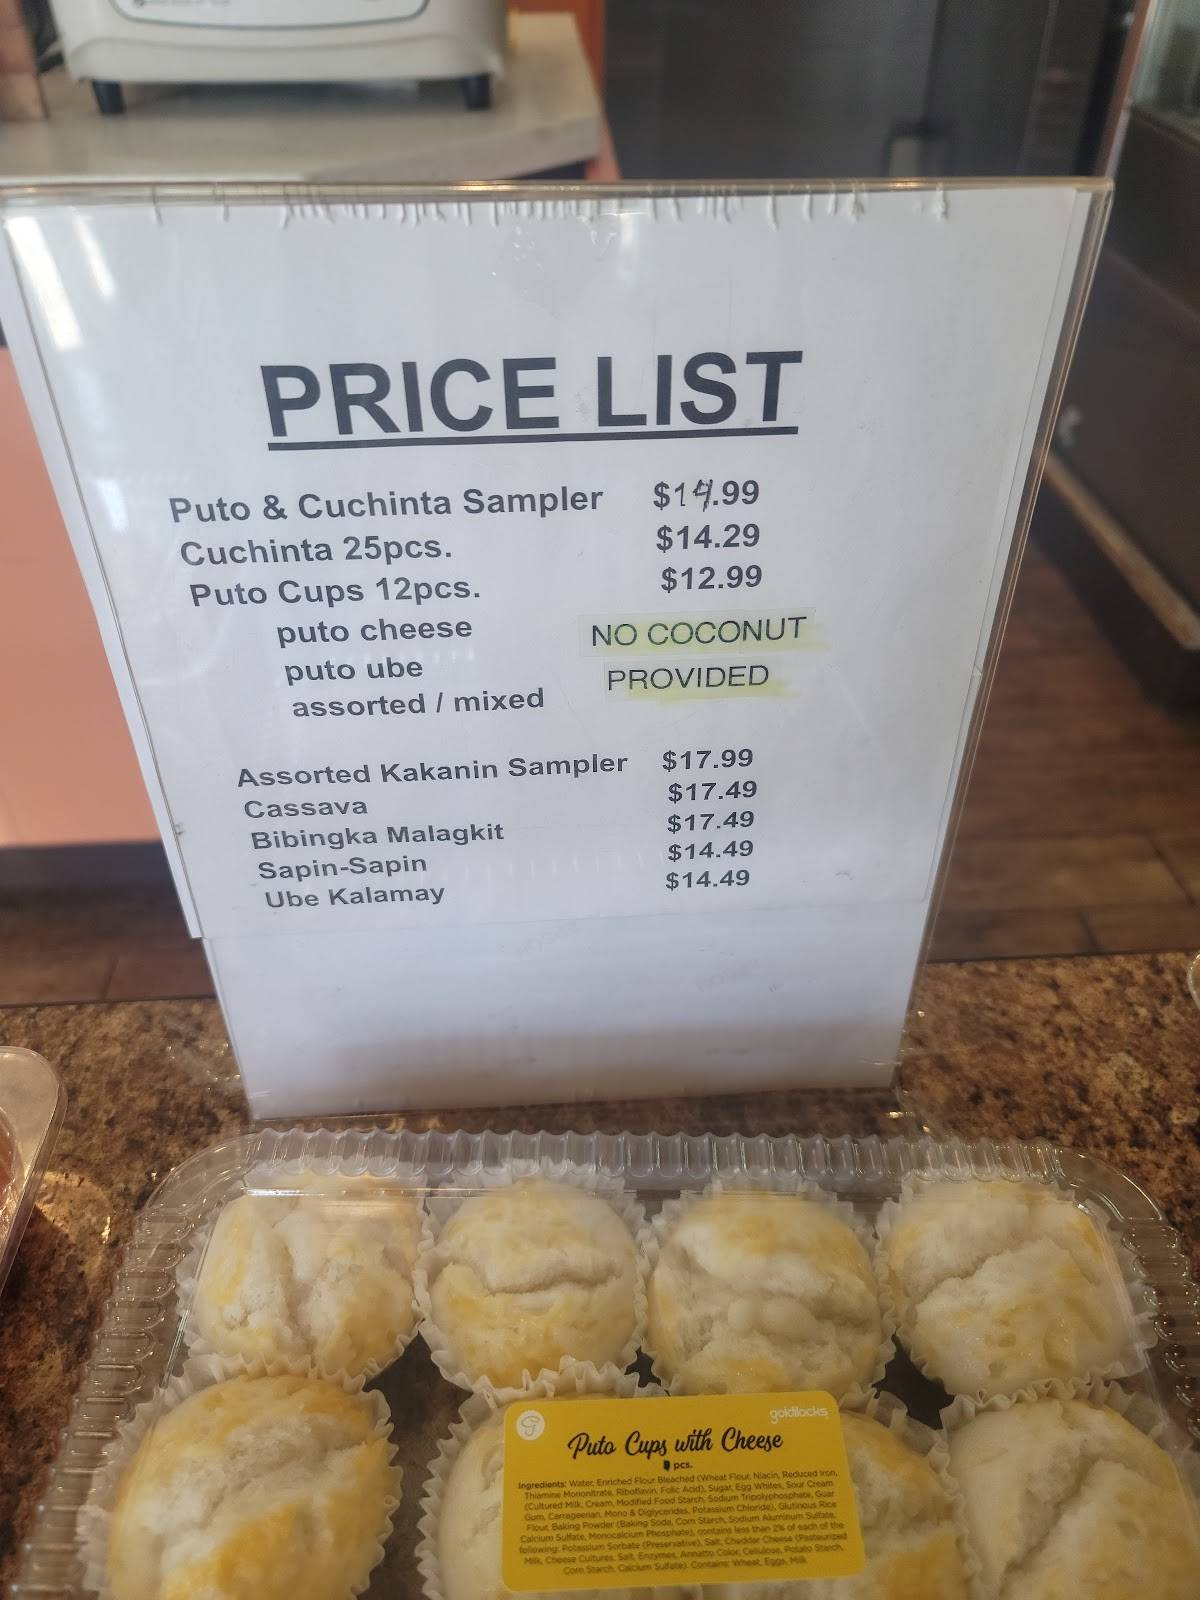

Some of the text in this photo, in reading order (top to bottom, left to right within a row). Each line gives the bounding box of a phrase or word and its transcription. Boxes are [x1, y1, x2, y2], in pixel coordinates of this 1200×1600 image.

[260, 351, 803, 436] PRICE LIST
[170, 486, 603, 522] Puto & Cuchinta Sampler
[181, 536, 451, 565] Cuchinta 25pcs.
[657, 524, 759, 553] $14.29
[661, 565, 762, 593] $12.99
[190, 577, 480, 608] Puto Cups 12pcs.
[277, 619, 472, 648] puto cheese
[593, 617, 807, 646] NO COCONUT
[285, 657, 422, 686] puto ube
[609, 665, 768, 690] PROVIDED
[293, 688, 543, 717] assorted / mixed
[238, 754, 628, 787] Assorted Kakanin Sampler
[663, 749, 753, 772] $17.99
[668, 781, 757, 804] $17.49
[245, 801, 367, 818] Cassava
[668, 811, 754, 834] $17.49
[251, 824, 504, 849] Bibingka Malagkit
[669, 840, 753, 862] $14.49
[259, 856, 426, 882] Sapin-Sapin
[666, 870, 749, 891] $14.49
[265, 887, 444, 907] Ube Kalamay
[769, 1406, 829, 1424] goldilocks
[567, 1427, 783, 1459] Puto Cups with Cheese
[673, 1461, 693, 1470] pcs.
[518, 1481, 566, 1490] Ingredients:
[597, 1477, 632, 1486] Enriched
[634, 1476, 655, 1484] Flour
[658, 1474, 694, 1483] Bleached
[697, 1473, 726, 1482] (Wheat
[754, 1472, 778, 1480] Niacin,
[782, 1470, 817, 1478] Reduced
[661, 1486, 680, 1494] Folic
[736, 1483, 751, 1492] Egg
[524, 1502, 563, 1511] (Cultured
[617, 1497, 651, 1505] Modified
[655, 1496, 675, 1504] Food
[708, 1494, 736, 1502] Sodium
[605, 1509, 627, 1517] Mono
[693, 1505, 734, 1513] Potassium
[520, 1535, 555, 1543] Calcium
[787, 1523, 795, 1531] of
[552, 1522, 580, 1531] Baking
[583, 1521, 614, 1529] Powder
[617, 1520, 648, 1528] (Baking
[729, 1514, 759, 1522] Sodium
